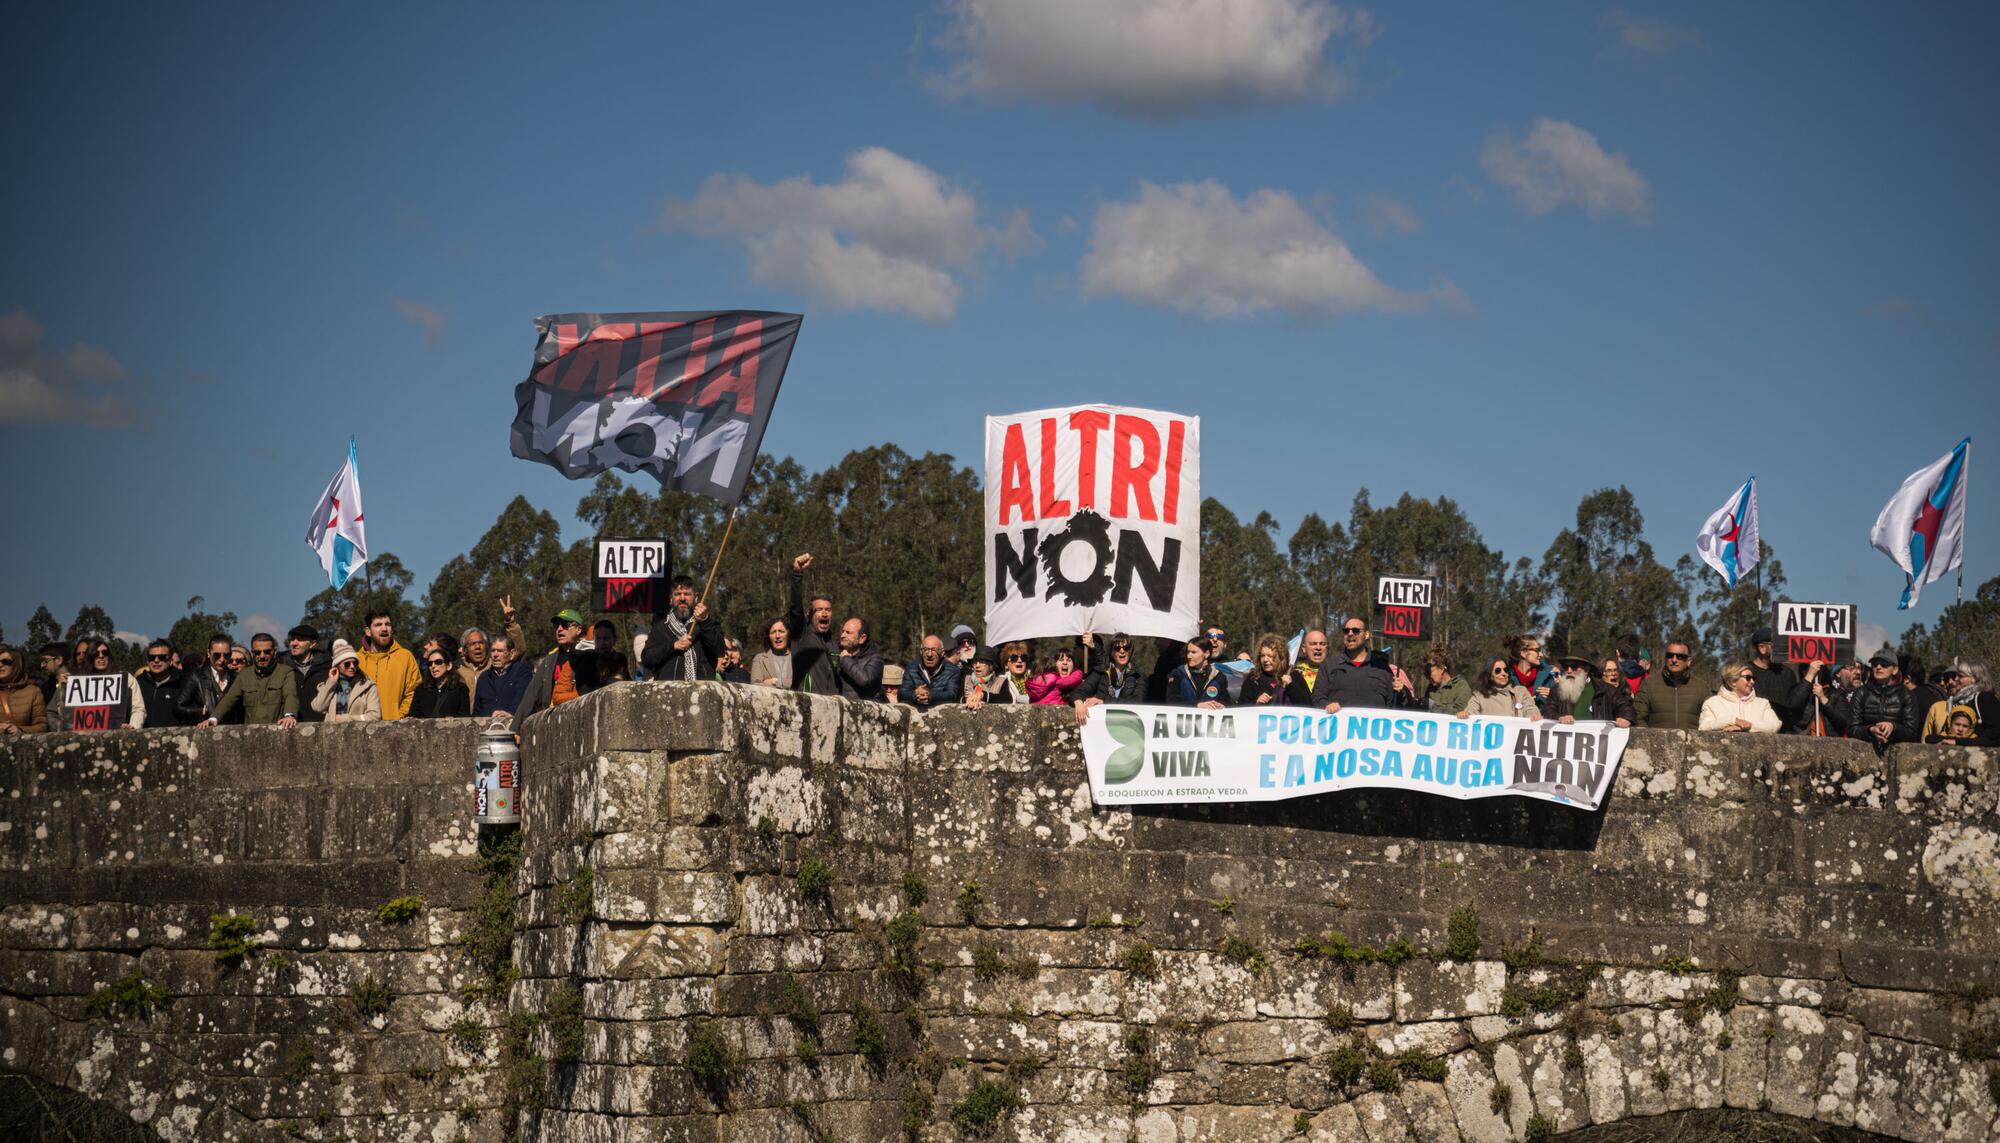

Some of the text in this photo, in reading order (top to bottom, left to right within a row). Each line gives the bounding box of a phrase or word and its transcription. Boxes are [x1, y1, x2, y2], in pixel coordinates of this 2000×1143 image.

[998, 409, 1185, 526] ALTRI
[604, 546, 663, 574] ALTRI
[994, 508, 1182, 613] NON
[609, 581, 651, 609] NON
[1381, 581, 1429, 605] ALTRI
[1386, 609, 1418, 633] NON
[1785, 607, 1846, 634] ALTRI
[1791, 638, 1833, 661] NON
[68, 677, 120, 703] ALTRI
[75, 708, 106, 729] NON
[1152, 713, 1236, 739] A ULLA
[1257, 714, 1504, 751] POLO NOSO RÍO
[1513, 728, 1608, 765] ALTRI
[500, 761, 512, 787] ALTRI
[1152, 750, 1211, 778] VIVA
[1259, 748, 1504, 788] E A NOSA AUGA
[1513, 755, 1605, 798] NON
[478, 788, 486, 815] NON
[1167, 788, 1173, 796] A
[1176, 788, 1215, 796] ESTRADA
[1217, 787, 1248, 796] VEDRA
